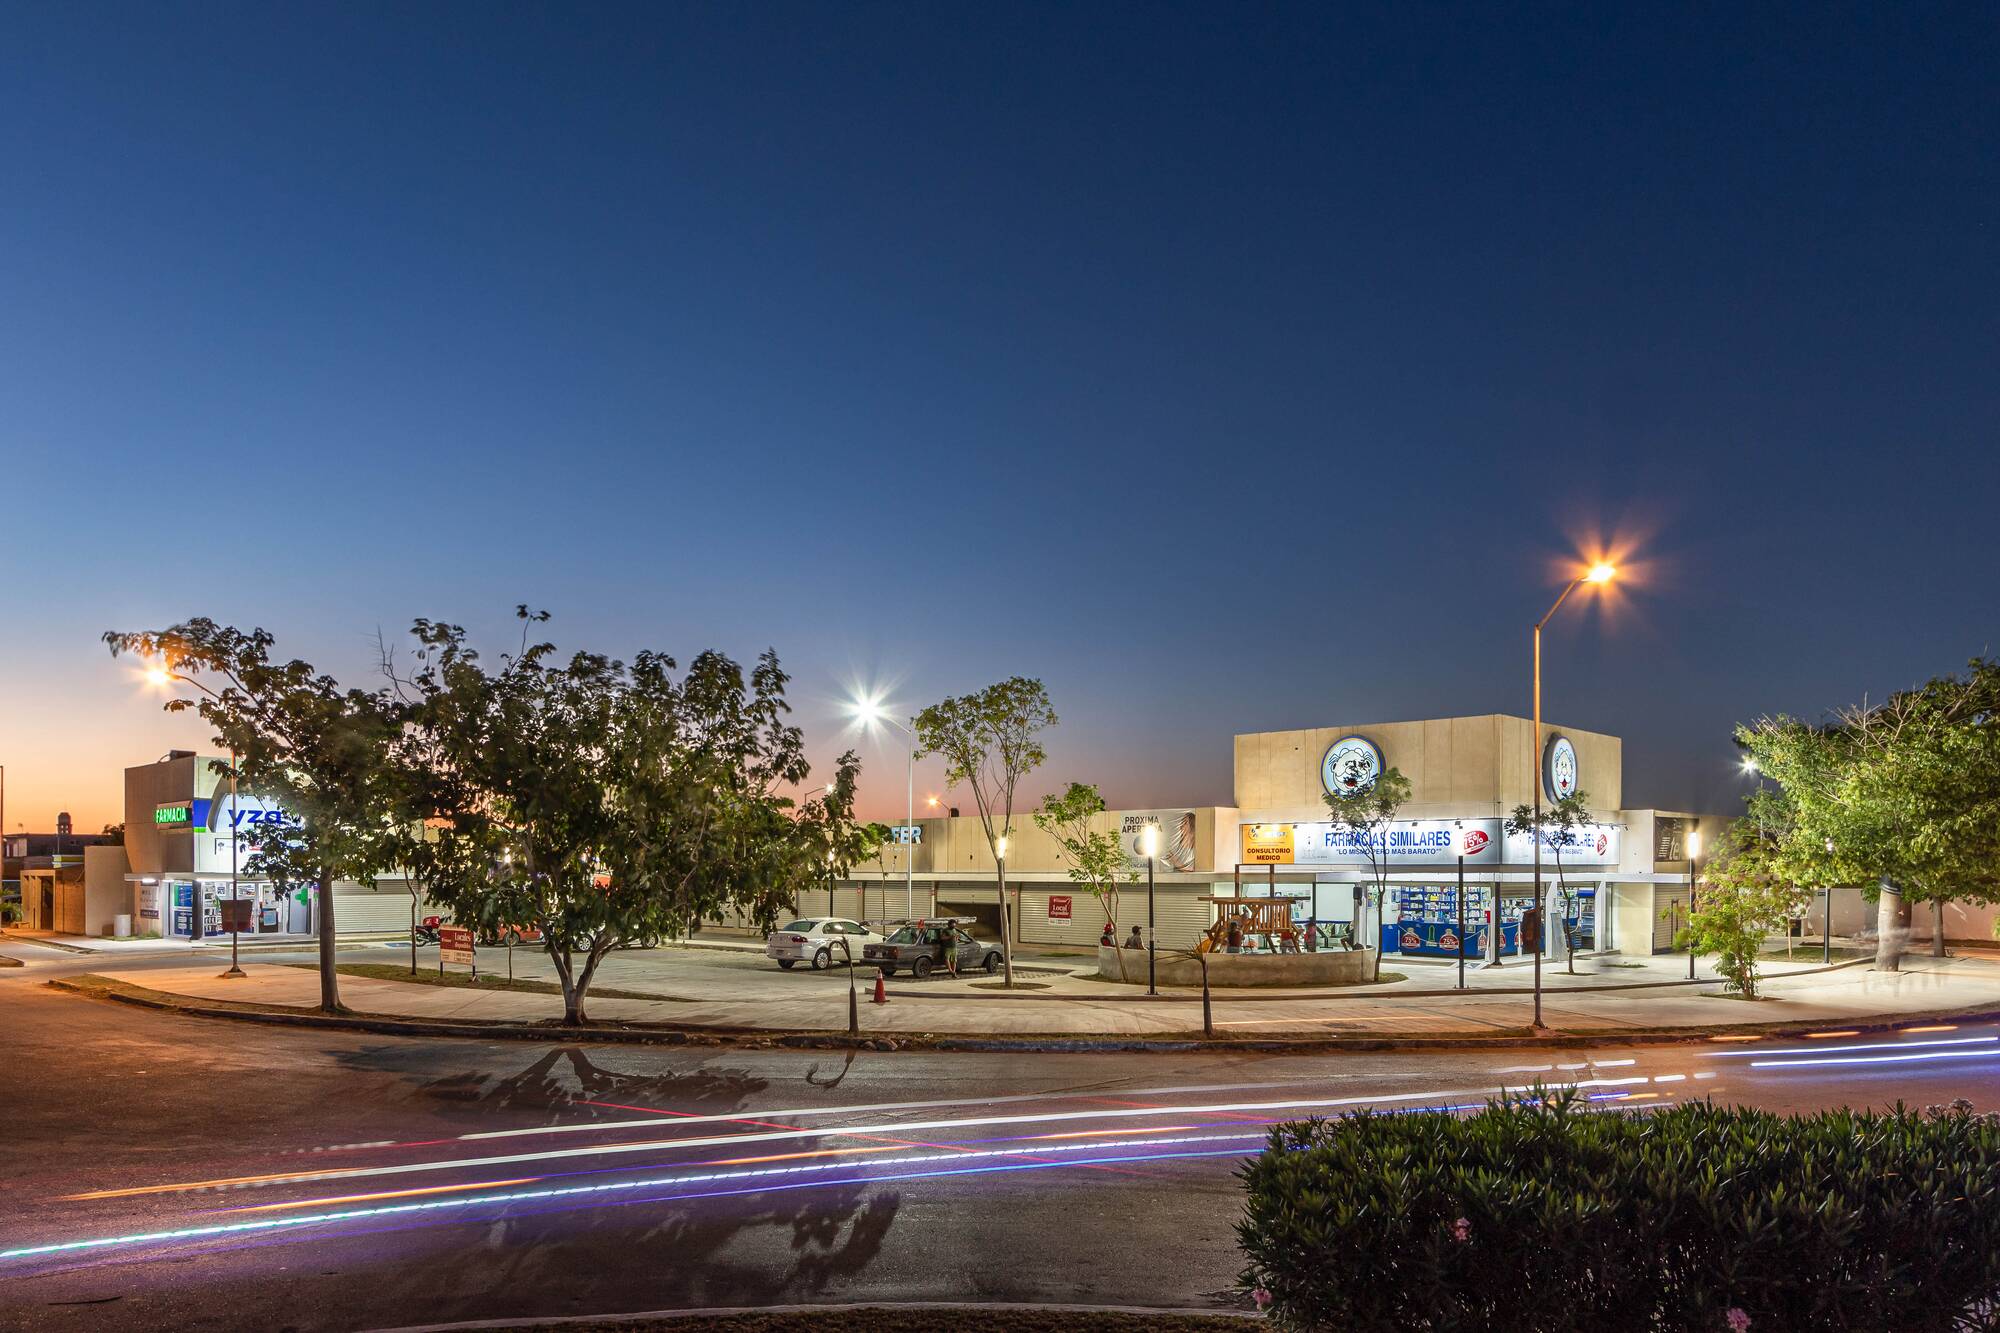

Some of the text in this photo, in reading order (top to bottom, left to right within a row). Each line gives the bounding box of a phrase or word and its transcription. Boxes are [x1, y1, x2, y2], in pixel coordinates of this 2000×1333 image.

[155, 806, 187, 824] FARMACIA
[228, 809, 282, 827] yza
[1124, 816, 1160, 825] PROXIMA
[884, 826, 922, 844] FER
[1122, 824, 1163, 834] APERA
[1325, 831, 1386, 847] FARMACIAS
[1389, 831, 1451, 847] SIMILARES
